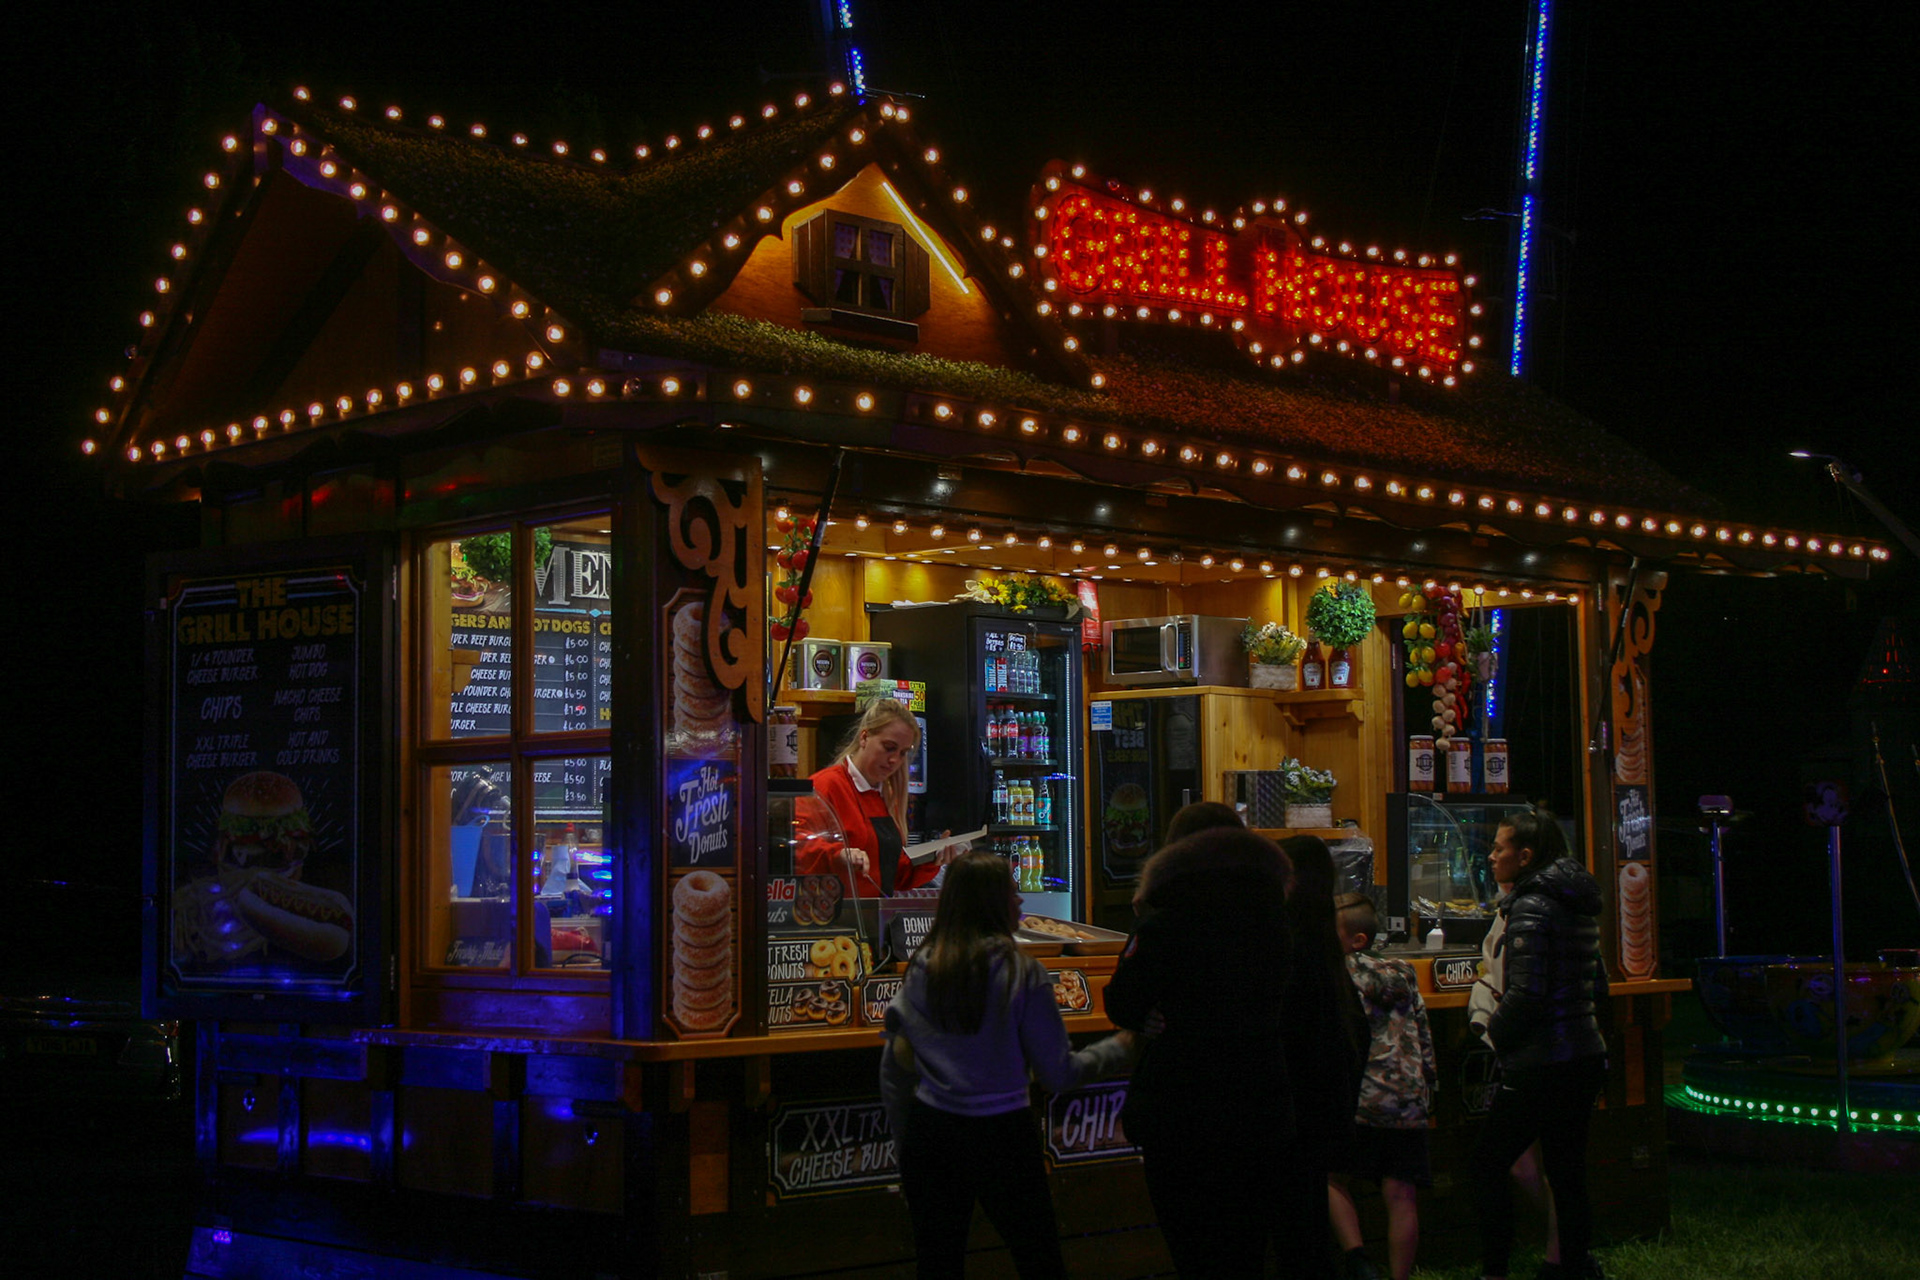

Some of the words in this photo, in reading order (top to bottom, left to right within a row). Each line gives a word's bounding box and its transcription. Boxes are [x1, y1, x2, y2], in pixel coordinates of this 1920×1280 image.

[1053, 193, 1248, 307] GRILL
[1254, 242, 1459, 364] HOUSE
[236, 577, 287, 609] THE
[178, 613, 251, 645] GRILL
[257, 604, 355, 640] HOUSE
[552, 620, 591, 634] DOGS
[470, 633, 487, 647] BEEF
[291, 643, 326, 661] JUMBO
[186, 668, 219, 686] CHEESE
[221, 665, 258, 682] BURGER
[289, 664, 307, 681] HOT
[308, 661, 328, 678] DOG
[471, 668, 496, 681] CHEESE
[998, 664, 1008, 688] PRIME
[273, 688, 307, 706] NACHO
[307, 687, 343, 704] CHEESE
[463, 685, 498, 697] POUNDER
[914, 690, 925, 701] 50
[201, 695, 243, 724] CHIPS
[293, 706, 321, 724] CHIPS
[465, 702, 492, 715] CHEESE
[194, 736, 215, 751] XXL
[217, 733, 251, 750] TRIPLE
[287, 731, 307, 748] HOT
[307, 730, 329, 746] AND
[186, 753, 219, 770] CHEESE
[220, 751, 258, 768] BURGER
[276, 750, 299, 767] COLD
[301, 748, 340, 765] DRINKS
[451, 771, 469, 783] ORK
[699, 765, 718, 798] Hot
[676, 780, 730, 843] Fresh
[688, 829, 728, 865] Donuts
[905, 936, 911, 947] 4
[775, 944, 809, 964] FRESH
[1446, 960, 1473, 984] CHIPS
[800, 1107, 854, 1152] XXL
[789, 1147, 855, 1187] CHEESE
